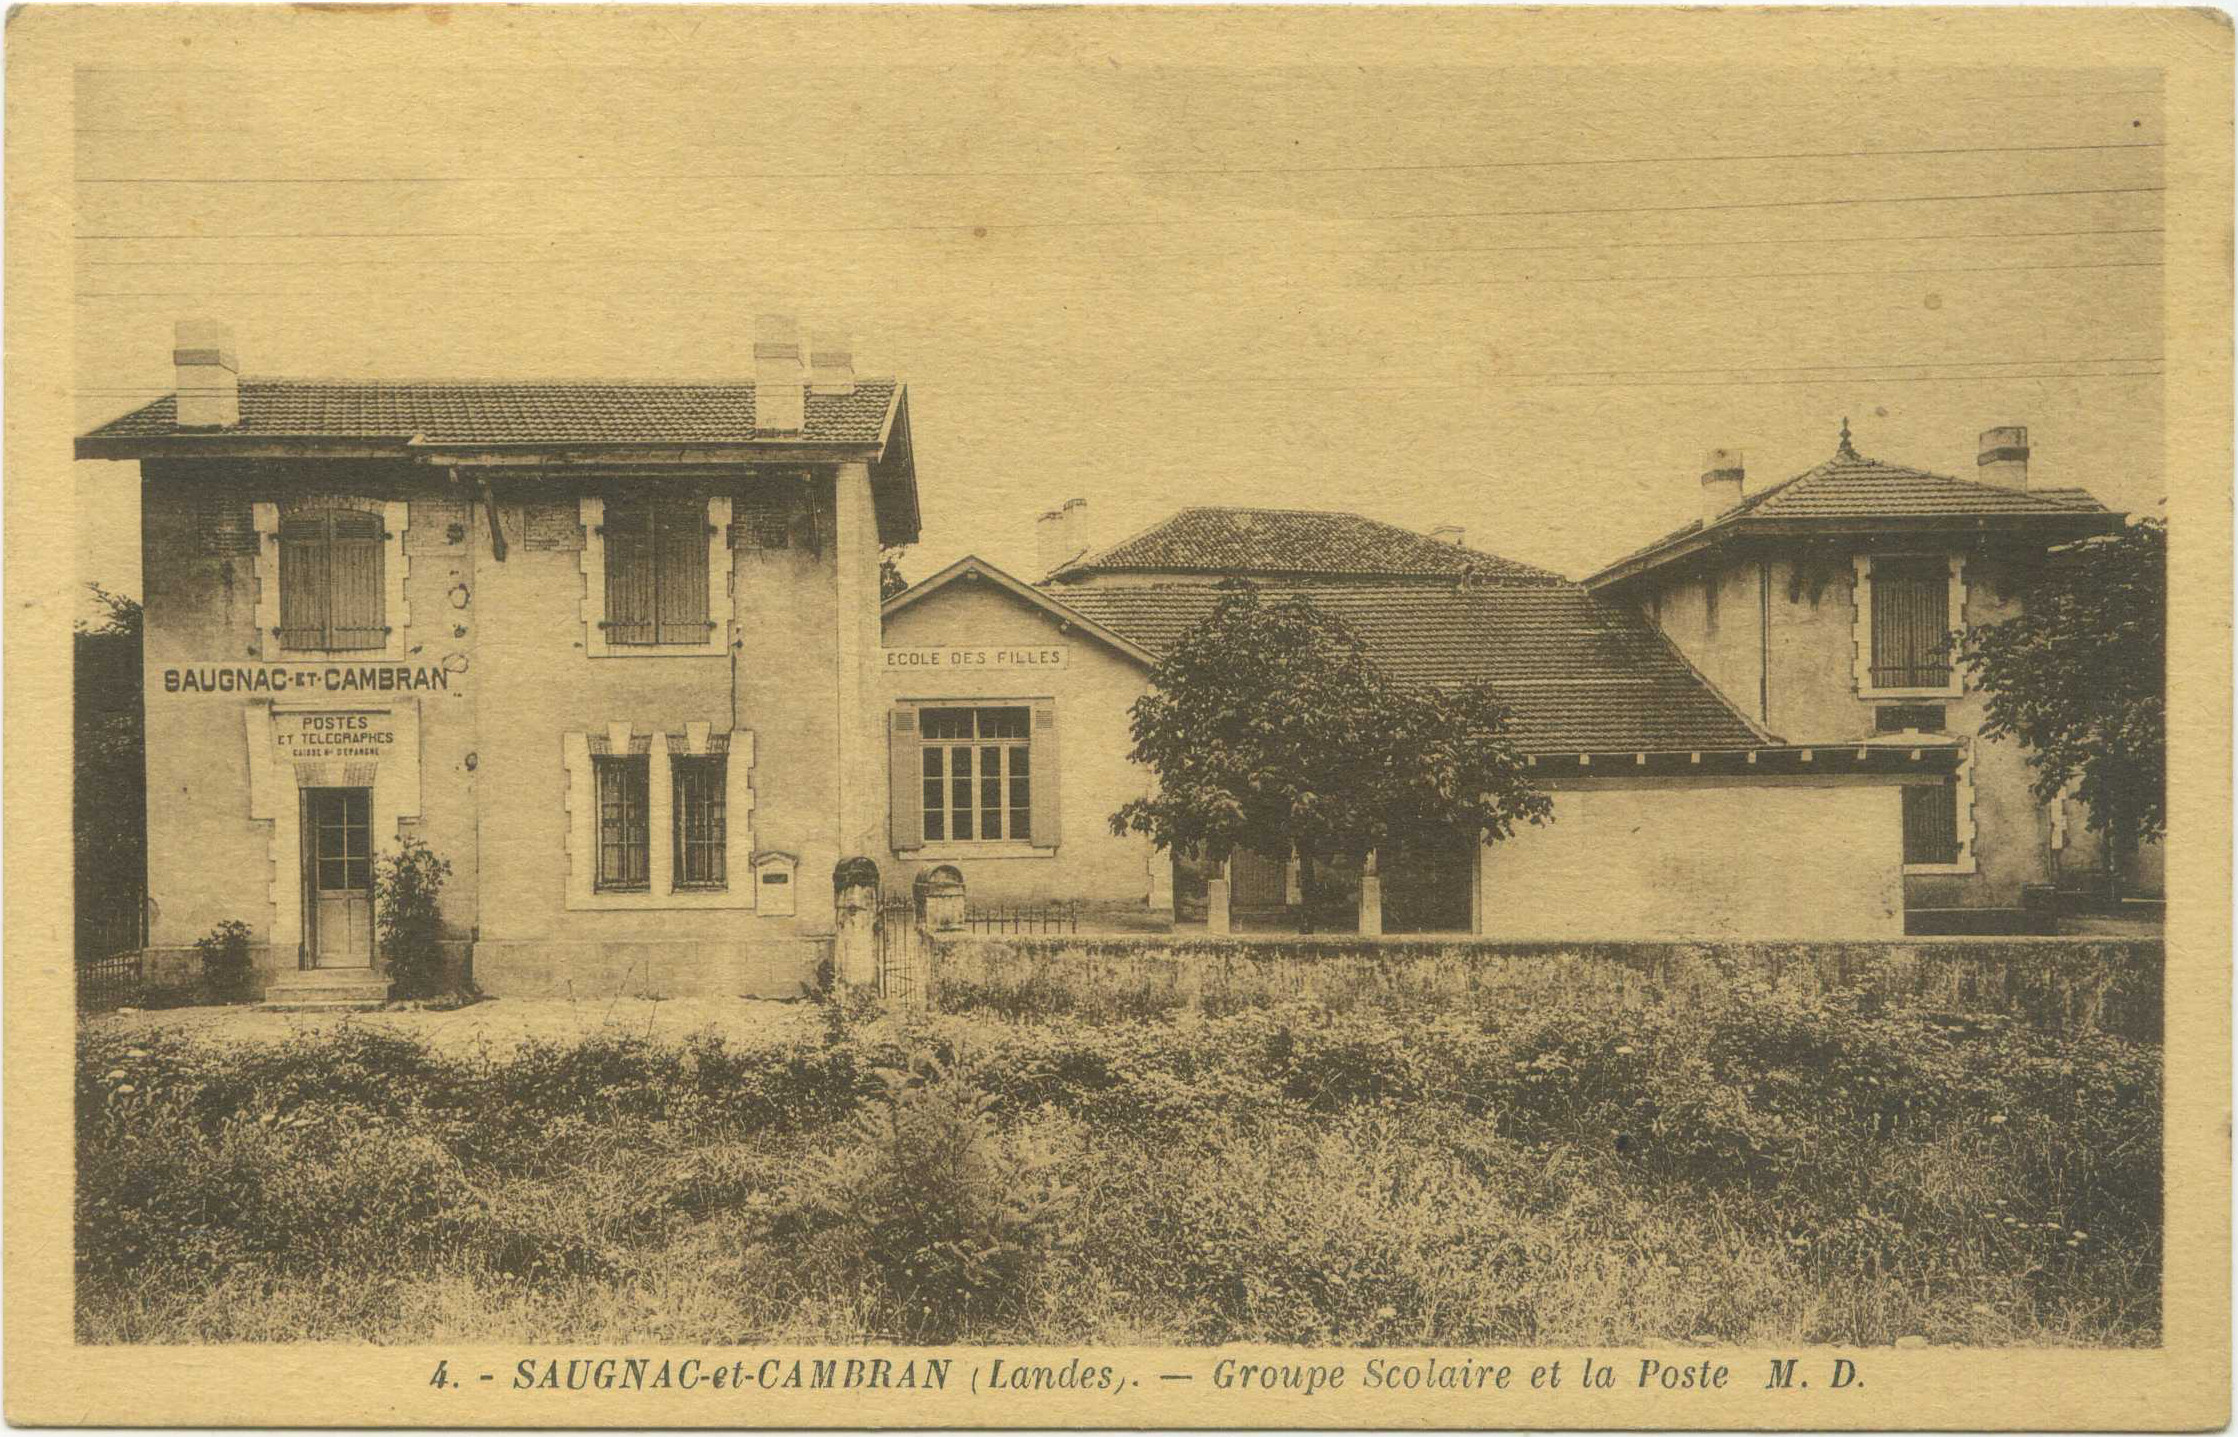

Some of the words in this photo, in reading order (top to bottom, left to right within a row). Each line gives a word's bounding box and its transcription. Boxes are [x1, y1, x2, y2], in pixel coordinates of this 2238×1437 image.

[887, 652, 939, 666] ECOLE
[951, 651, 985, 665] DES
[997, 650, 1060, 664] FILLES
[302, 716, 368, 730] POSTES
[277, 734, 293, 745] ET
[301, 732, 394, 745] TELEGRAPHES
